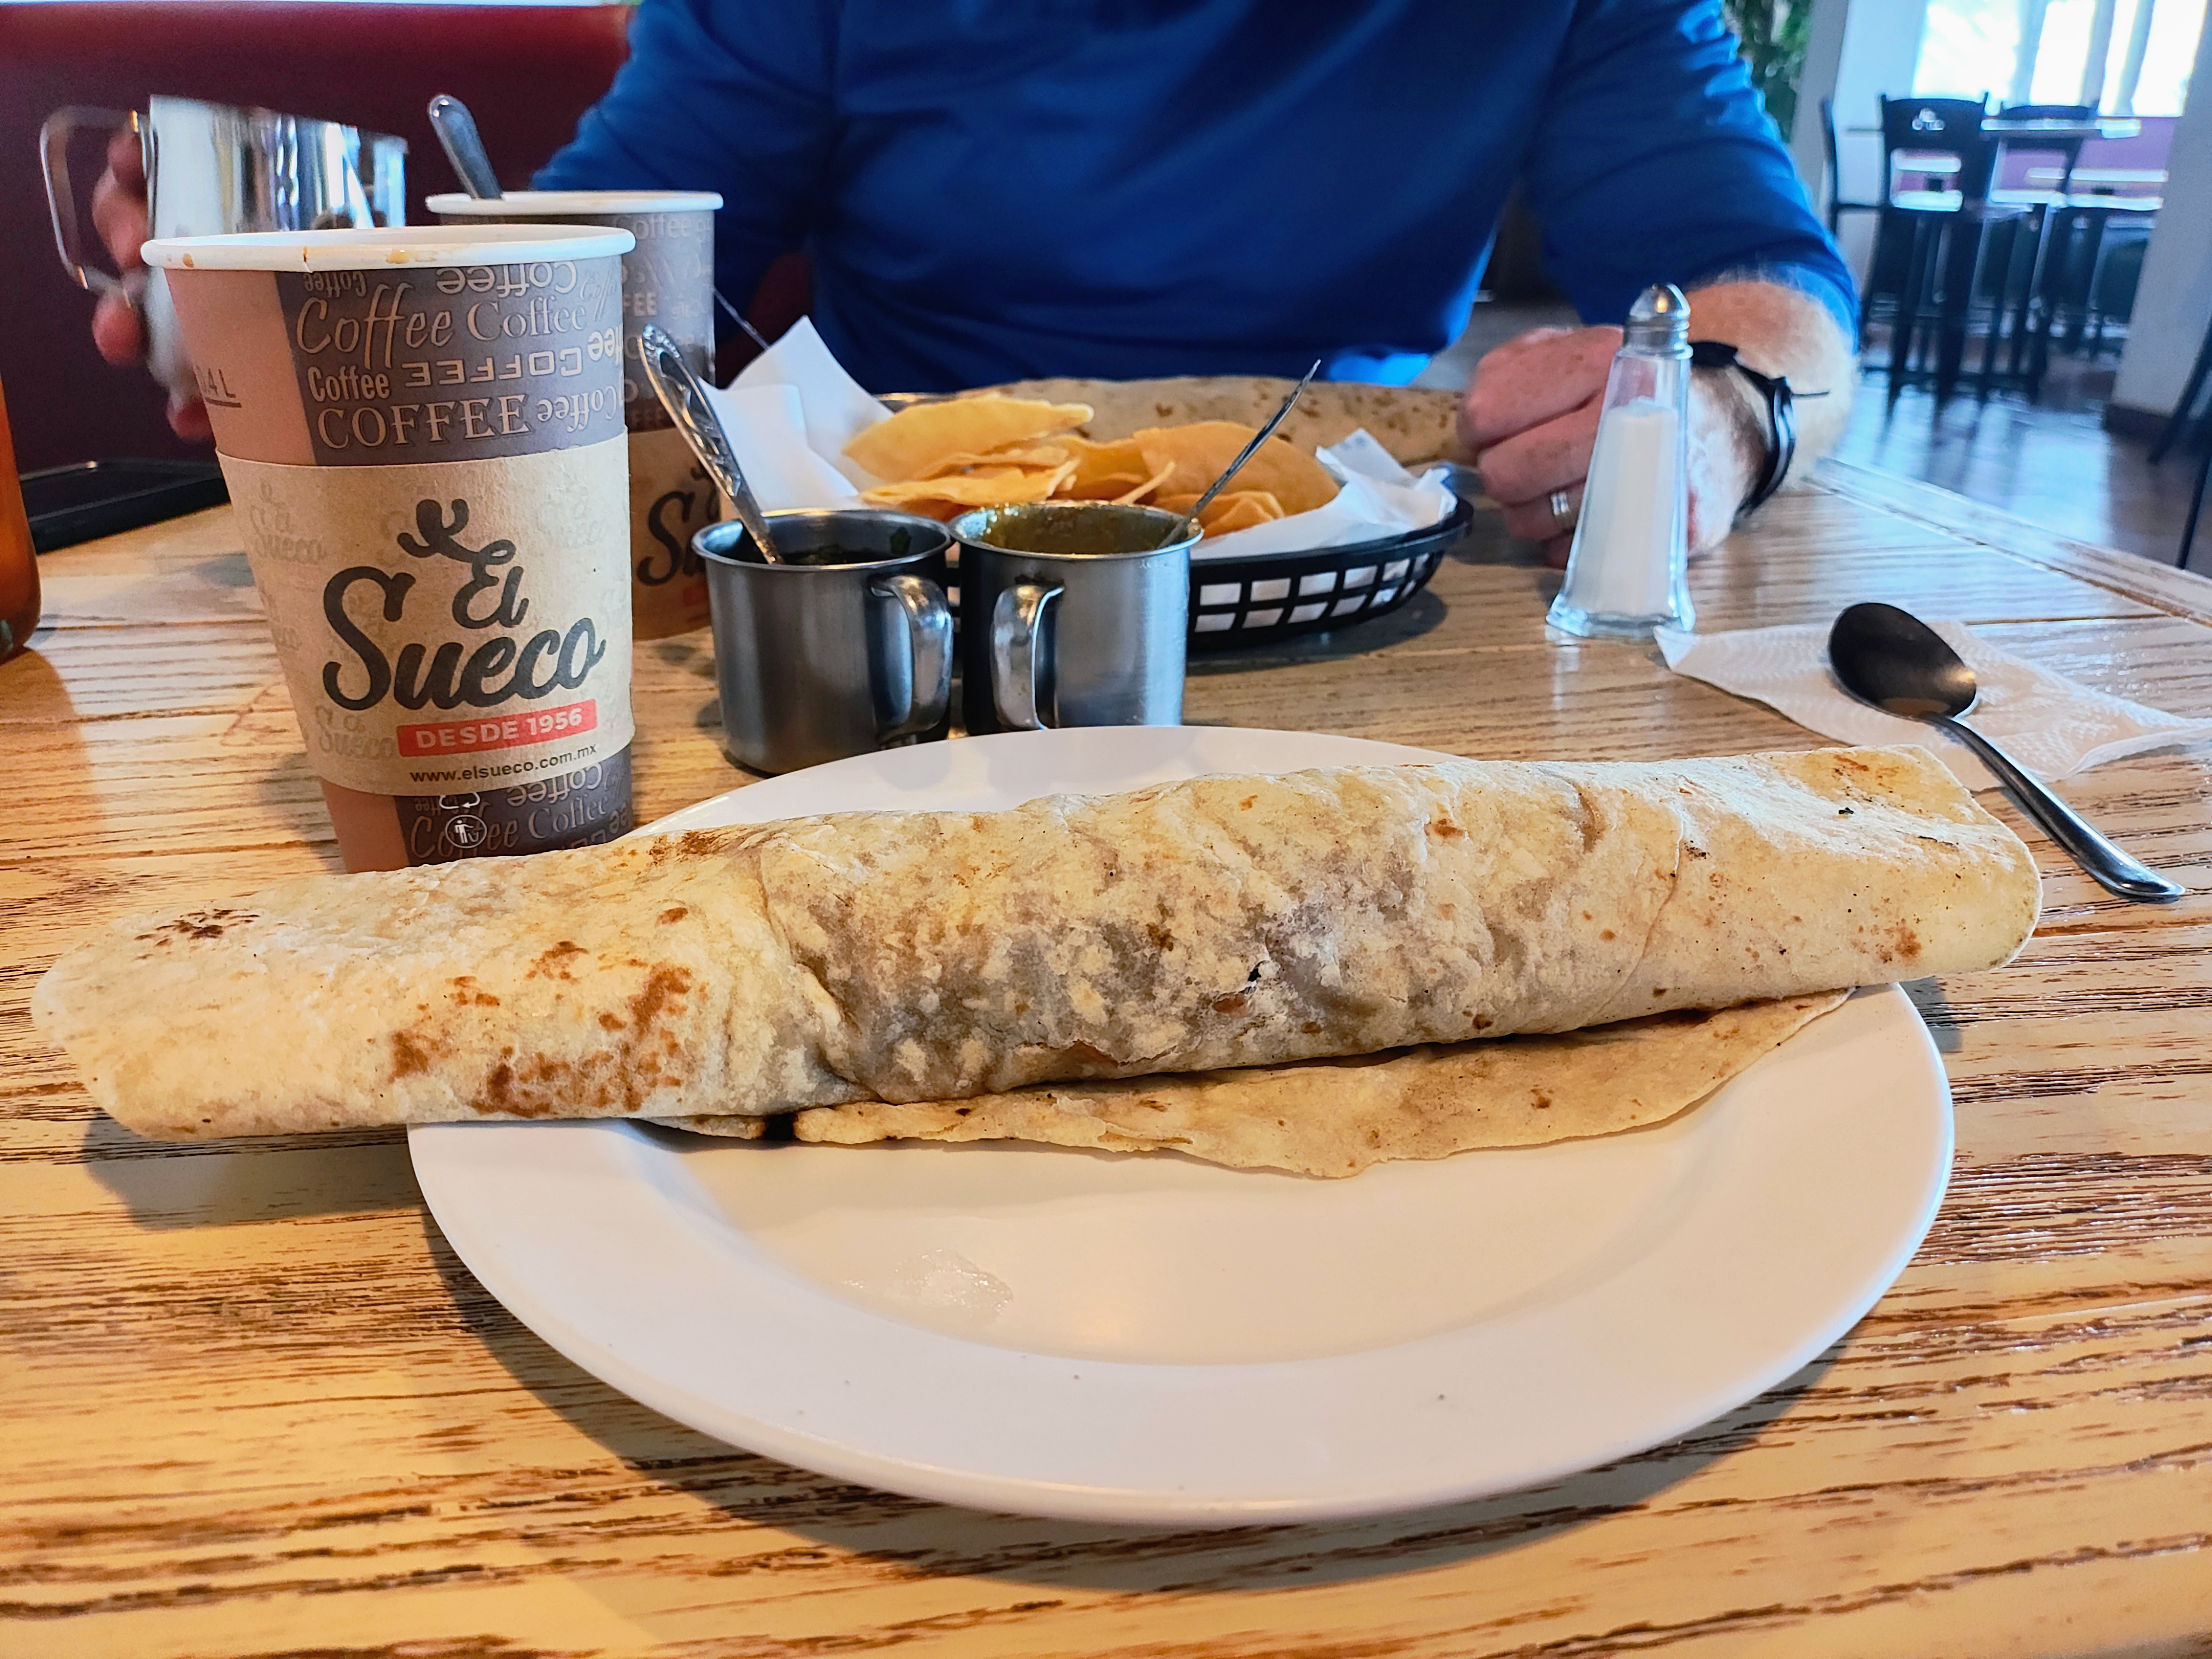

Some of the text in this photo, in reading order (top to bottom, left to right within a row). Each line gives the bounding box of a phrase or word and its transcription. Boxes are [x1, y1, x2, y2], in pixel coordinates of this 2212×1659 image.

[296, 282, 453, 370] Coffee
[467, 295, 586, 341] Coffee
[308, 365, 390, 402] Coffee
[401, 347, 582, 387] COFFEE
[318, 394, 531, 449] COFFEE
[453, 539, 529, 629] El
[322, 565, 606, 710] Sueco
[416, 707, 583, 749] DESDE 1956
[409, 743, 597, 782] www.elsueco.com.mx
[528, 793, 608, 840] Coffee
